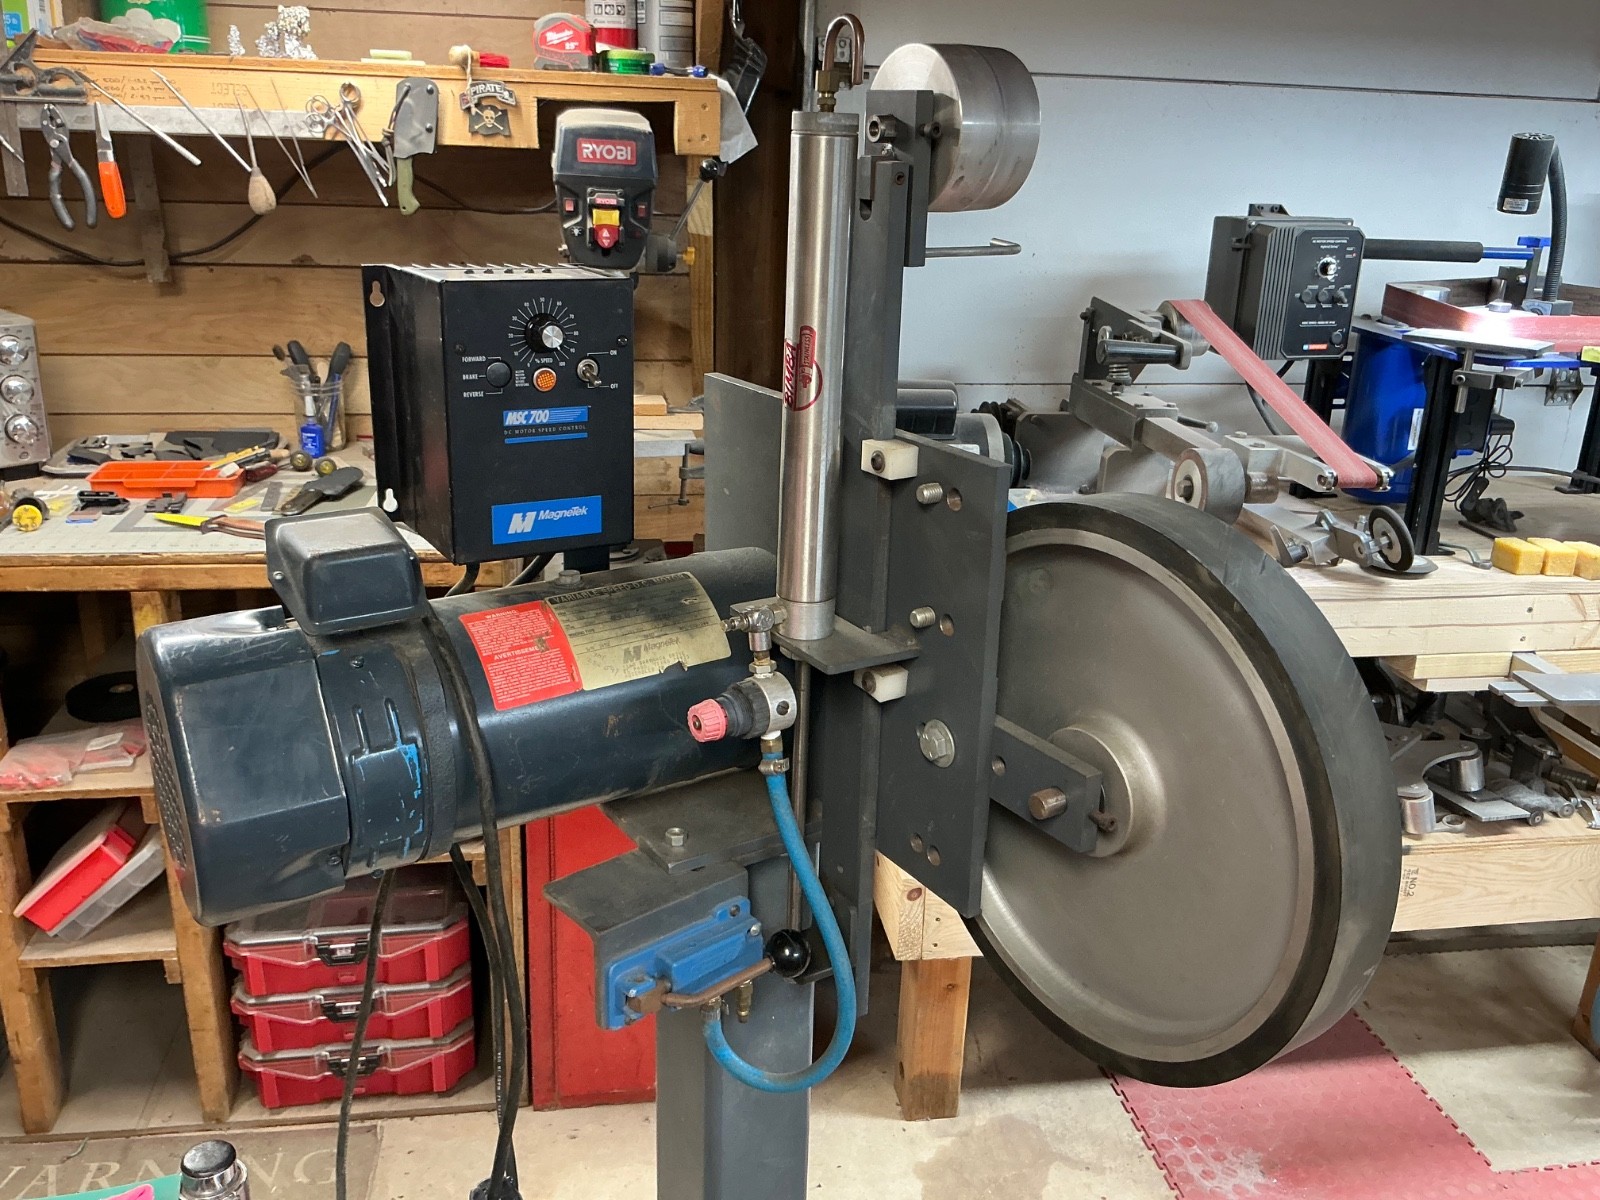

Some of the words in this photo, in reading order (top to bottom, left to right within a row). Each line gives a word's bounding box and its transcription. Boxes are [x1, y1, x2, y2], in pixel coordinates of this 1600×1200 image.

[581, 144, 632, 160] RYOBI
[804, 335, 812, 366] STAINLESS
[784, 340, 796, 408] BIMBA
[506, 411, 528, 425] MSC
[529, 410, 549, 423] 700
[538, 506, 588, 520] MagneTek
[553, 590, 598, 604] VARIABLE
[602, 582, 631, 595] SPEED
